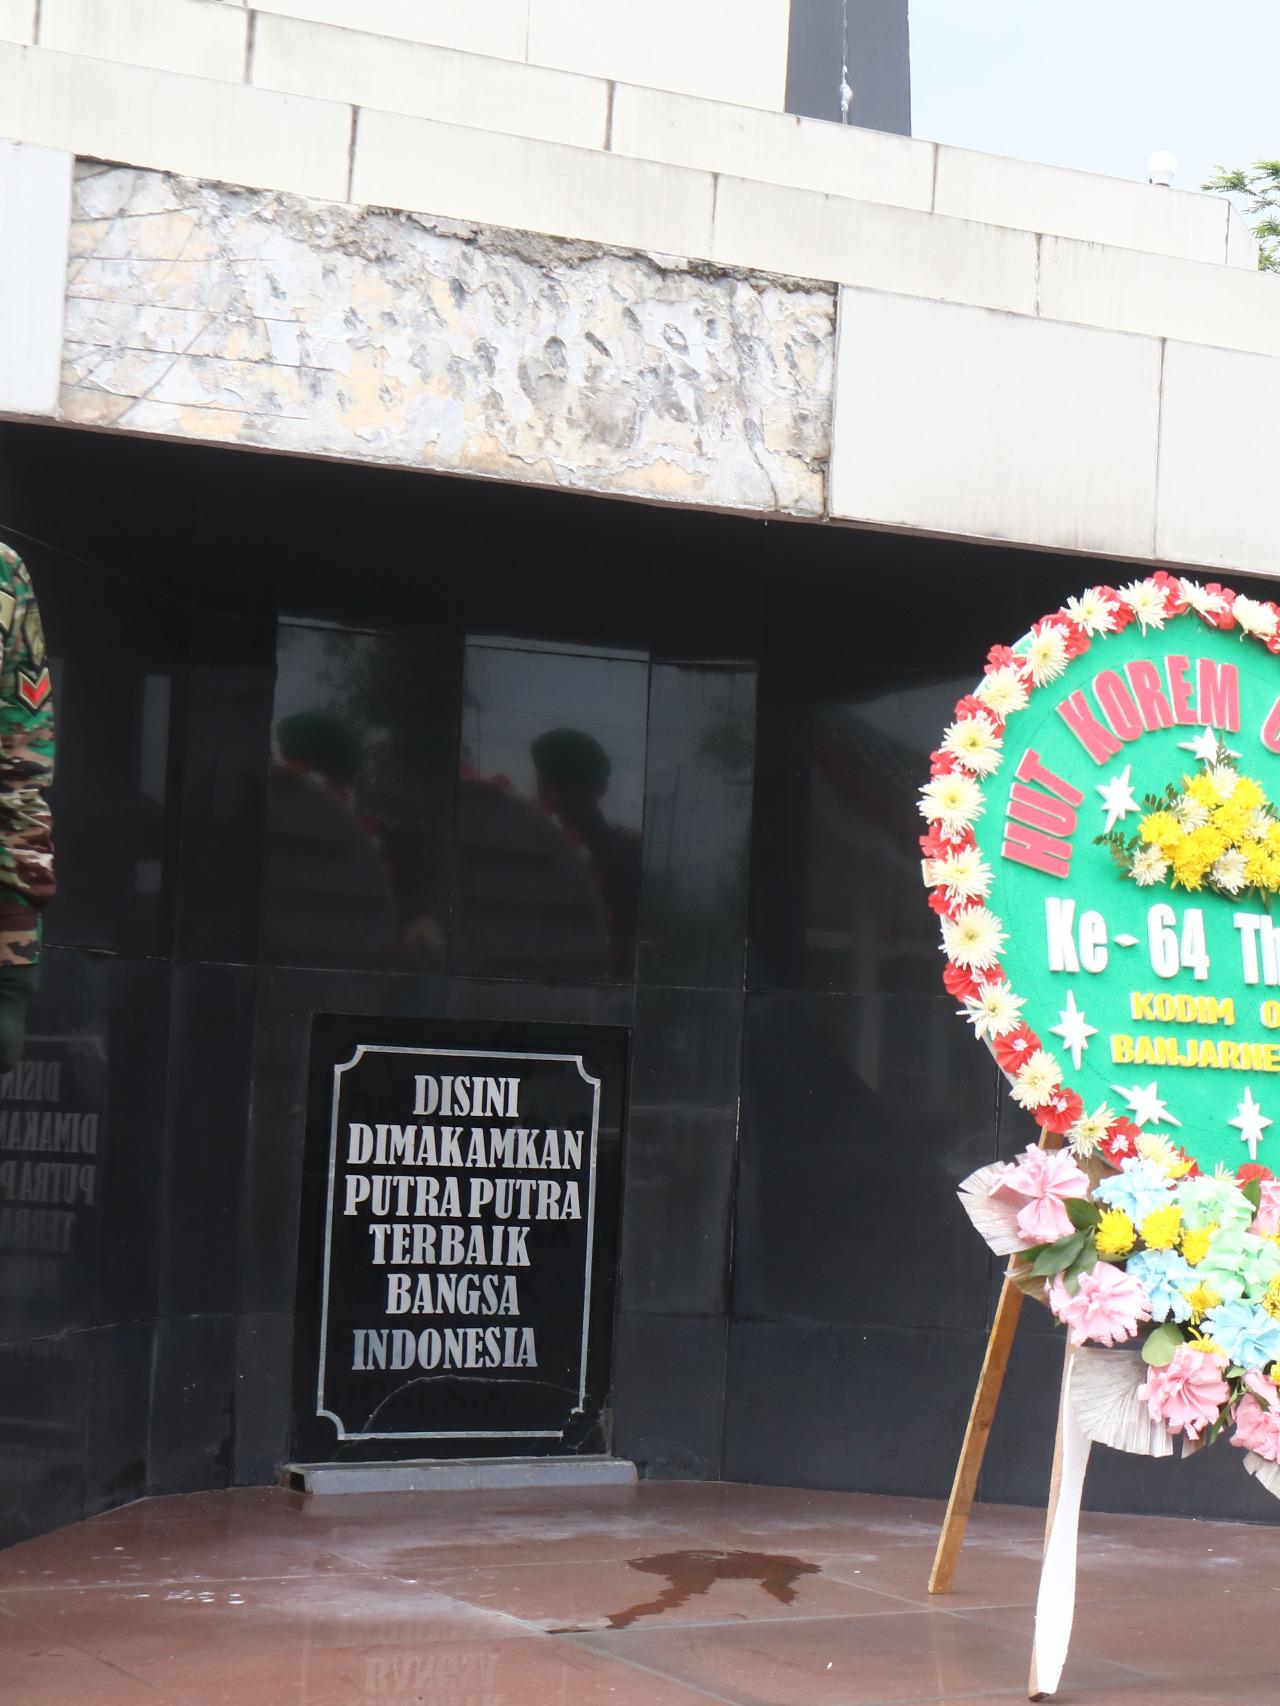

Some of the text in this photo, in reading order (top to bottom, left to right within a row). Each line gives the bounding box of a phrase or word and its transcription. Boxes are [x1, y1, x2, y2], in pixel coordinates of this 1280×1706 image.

[1001, 748, 1084, 878] HUT
[1056, 655, 1241, 766] KOREM
[1130, 992, 1235, 1026] KODIM
[413, 1075, 520, 1118] DISINI
[347, 1123, 584, 1170] DIMAKAMKAN
[344, 1175, 581, 1220] PUTRA PUTRA
[369, 1224, 531, 1267] TERBAIK
[386, 1274, 520, 1316] BANGSA
[352, 1327, 538, 1371] INDONESIA
